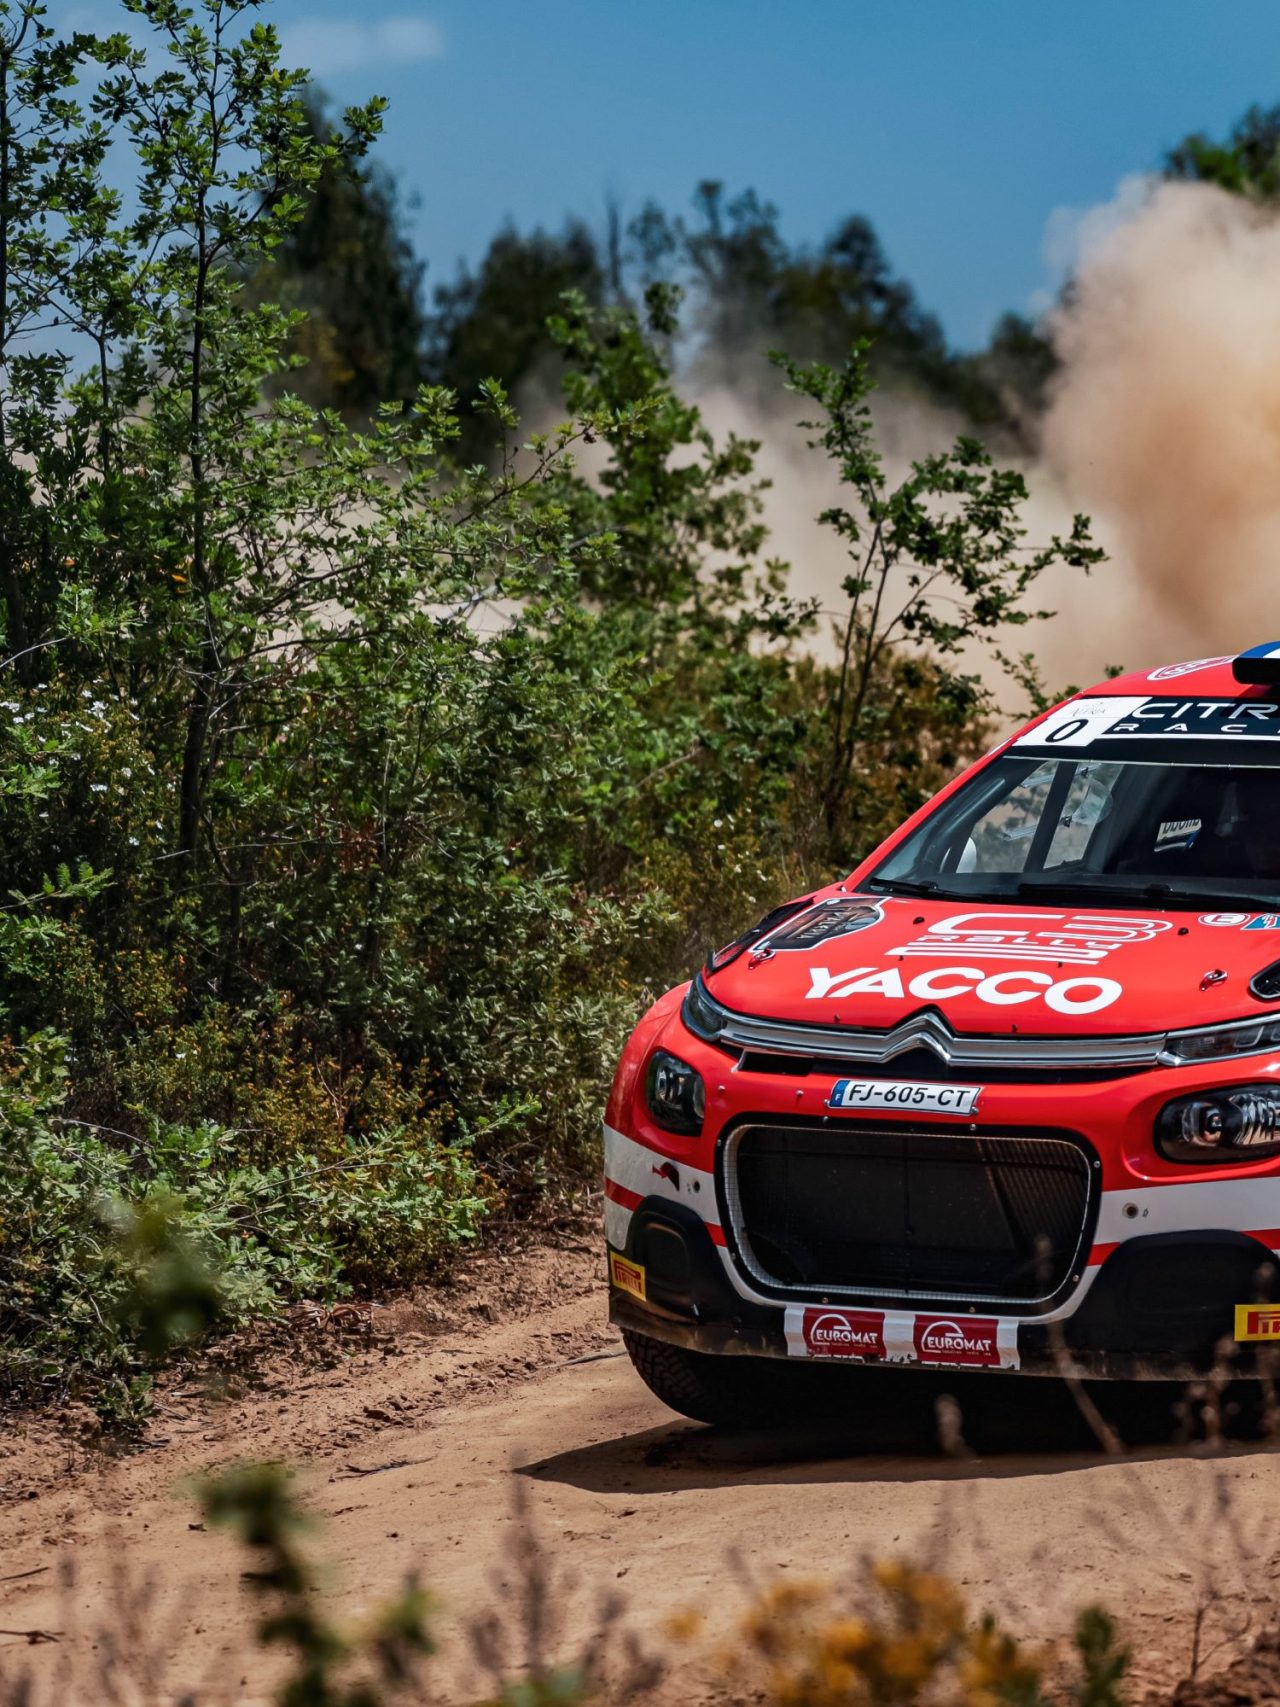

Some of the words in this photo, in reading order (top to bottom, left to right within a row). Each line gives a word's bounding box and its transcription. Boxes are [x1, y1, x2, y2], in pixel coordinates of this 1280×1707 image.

[1045, 718, 1089, 743] 0
[804, 967, 1122, 1015] YACCO
[835, 1093, 841, 1101] F
[849, 1084, 970, 1107] FJ-605-CT
[816, 1329, 878, 1345] EUROMAT
[928, 1336, 992, 1351] EUROMAT
